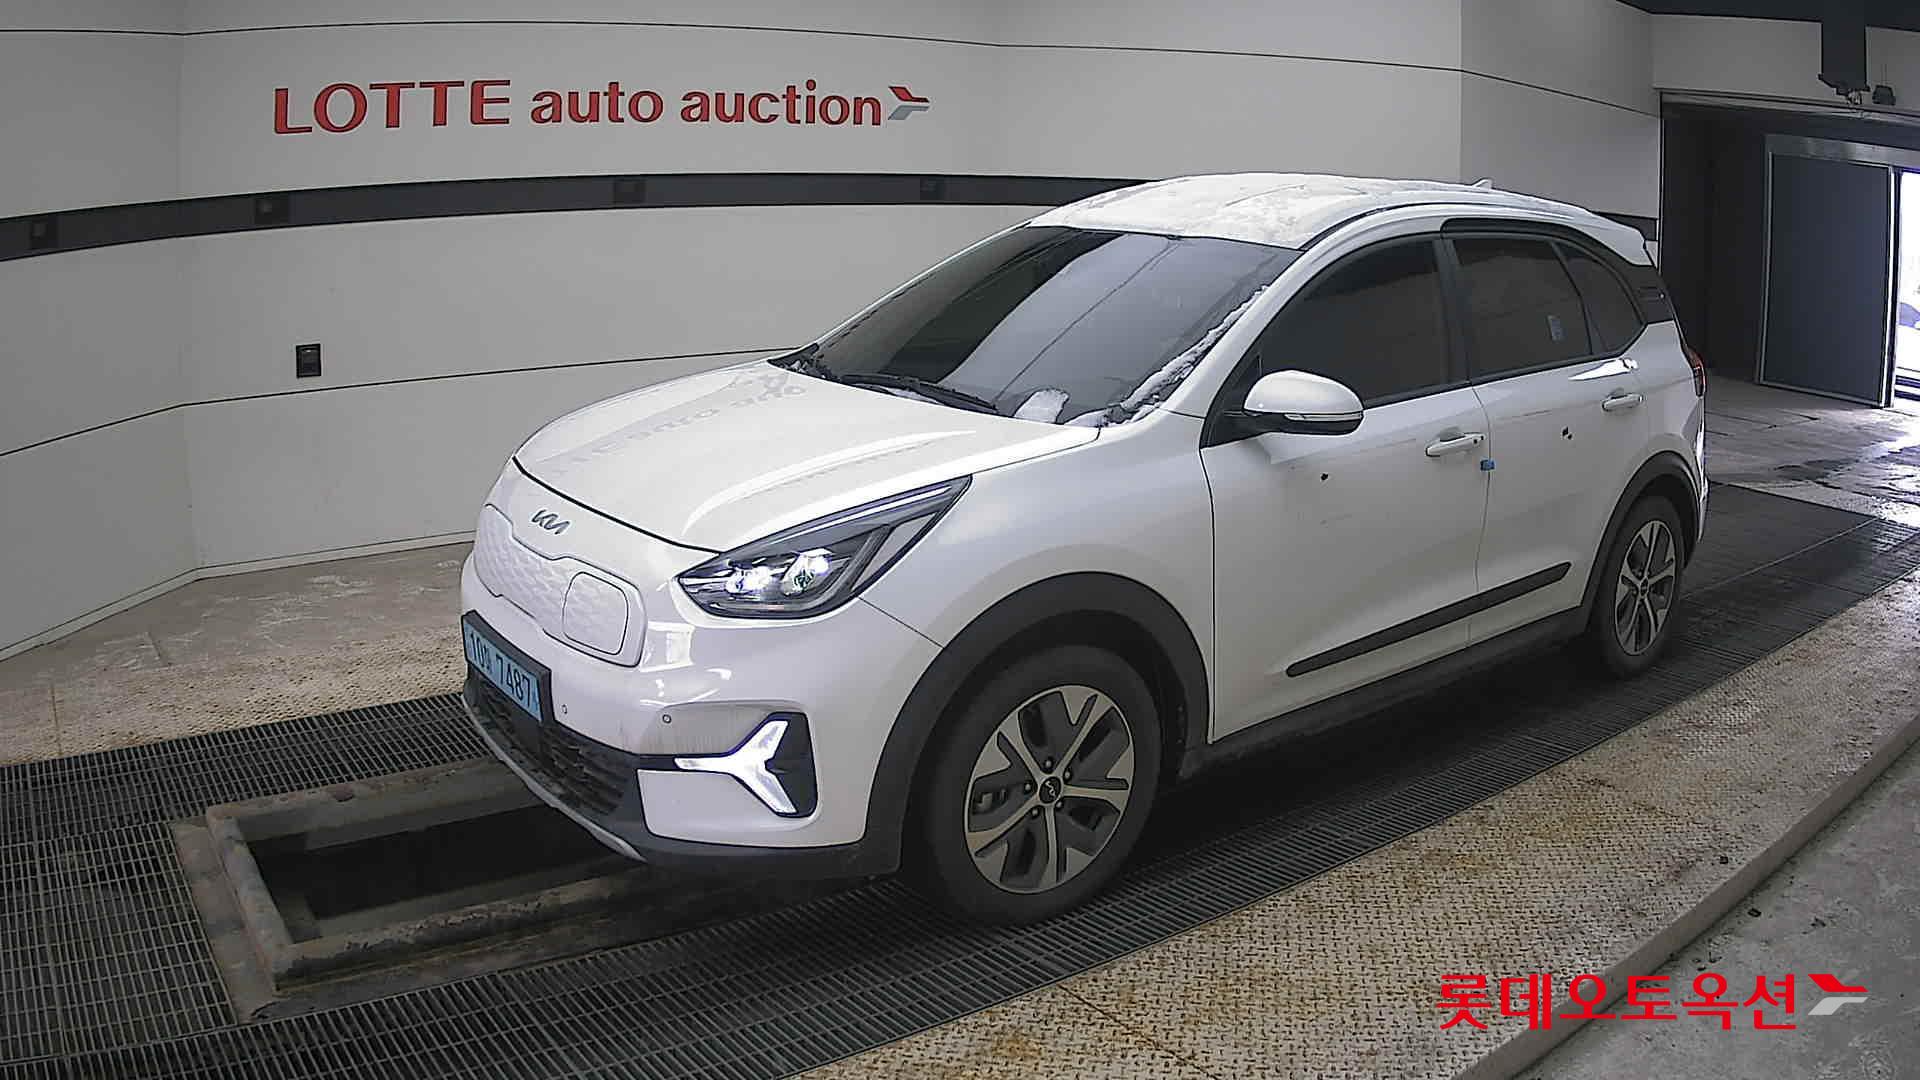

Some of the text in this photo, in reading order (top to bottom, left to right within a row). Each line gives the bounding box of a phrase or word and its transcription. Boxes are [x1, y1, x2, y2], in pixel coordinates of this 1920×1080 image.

[274, 79, 882, 134] LOTTE auto auction
[496, 653, 531, 708] 7487
